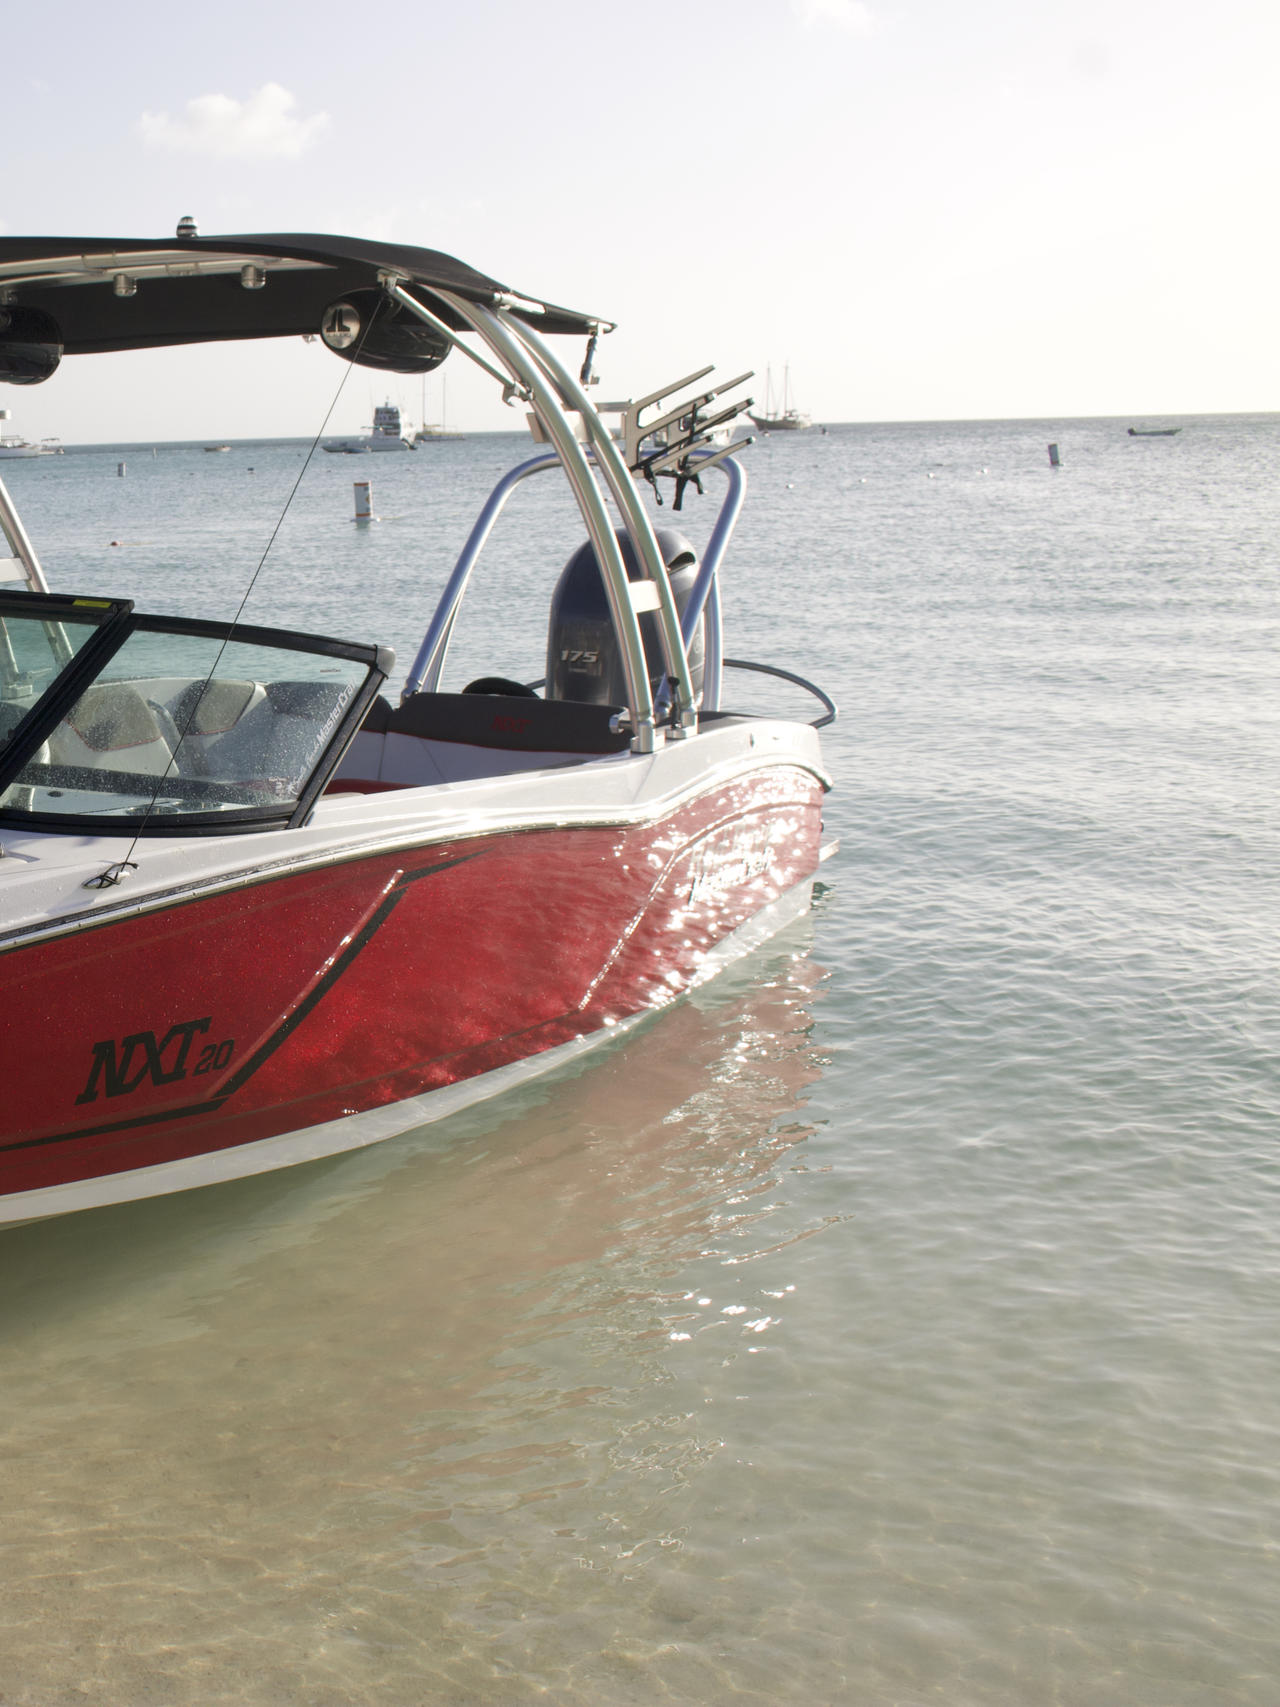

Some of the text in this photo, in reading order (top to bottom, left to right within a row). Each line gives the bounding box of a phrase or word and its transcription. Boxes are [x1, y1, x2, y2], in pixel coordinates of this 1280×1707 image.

[560, 649, 600, 663] 175
[316, 673, 358, 746] MasterCra
[74, 1016, 235, 1106] NXT 20
